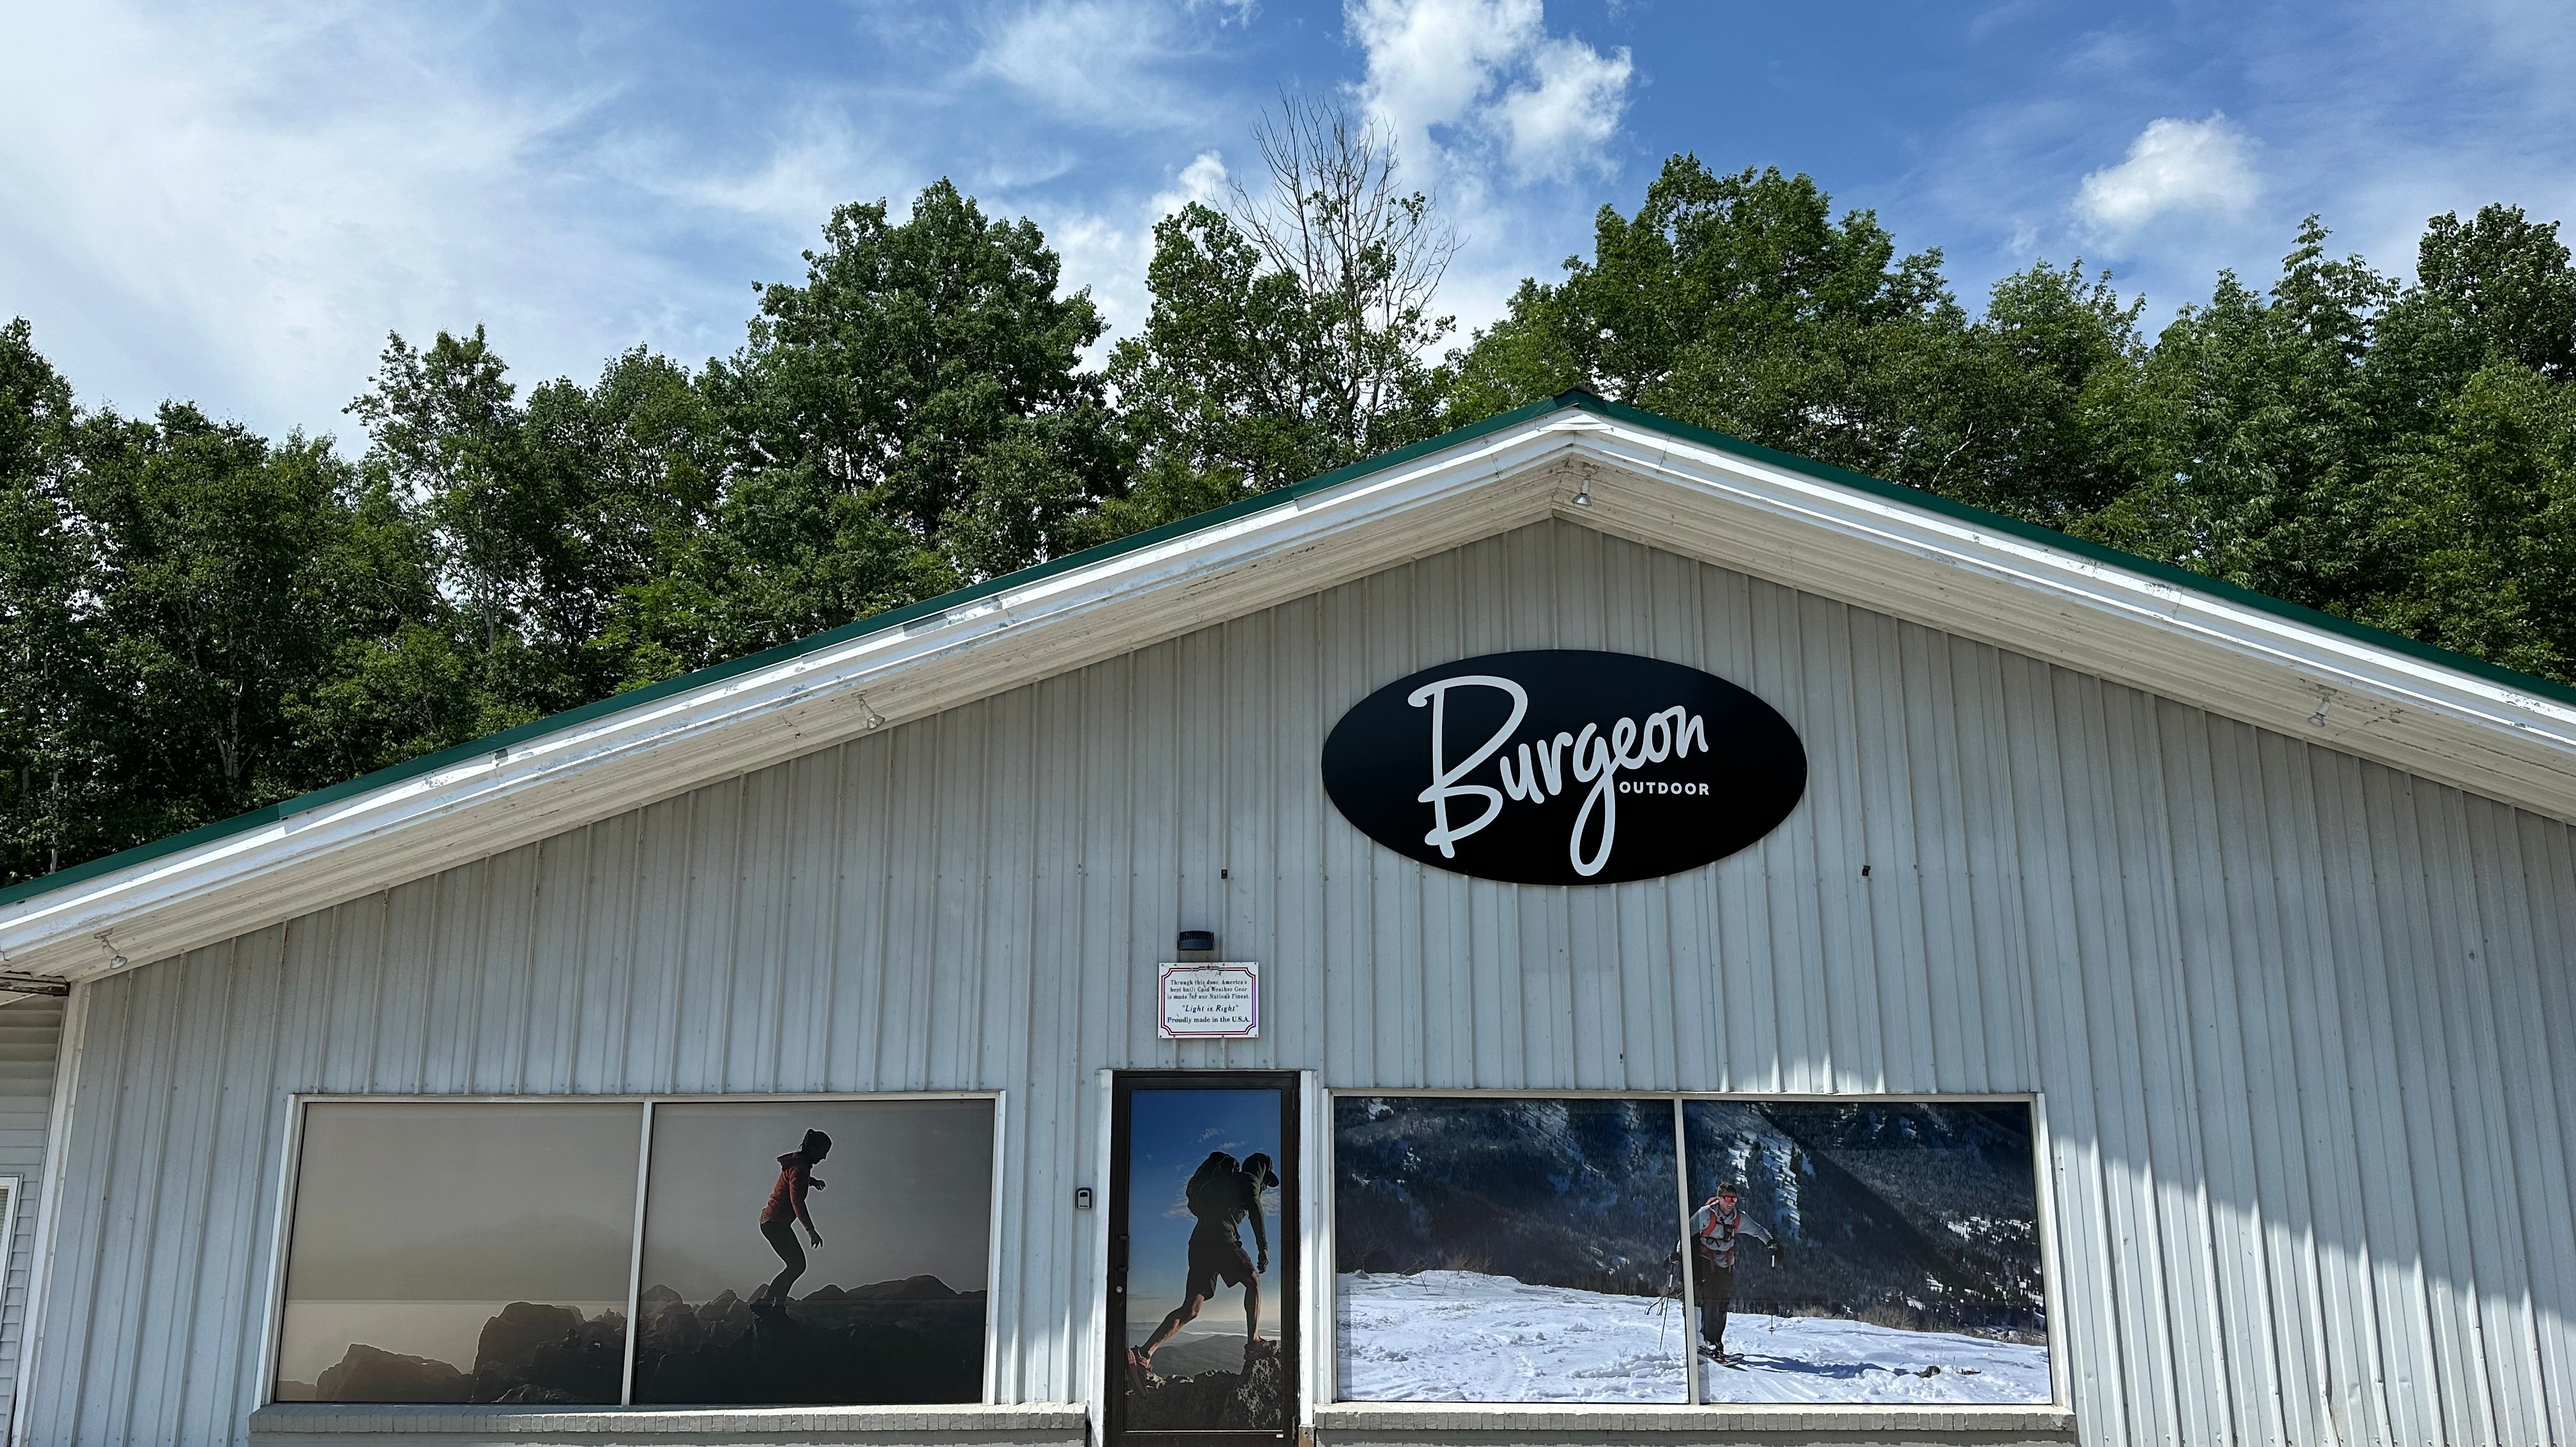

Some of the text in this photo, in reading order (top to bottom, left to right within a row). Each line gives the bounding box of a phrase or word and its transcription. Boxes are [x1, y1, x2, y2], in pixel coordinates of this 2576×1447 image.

[1407, 675, 1708, 876] Burgeon
[1619, 781, 1710, 795] OUTDOOR
[1182, 1004, 1204, 1013] "Light
[1215, 1004, 1239, 1013] Right"
